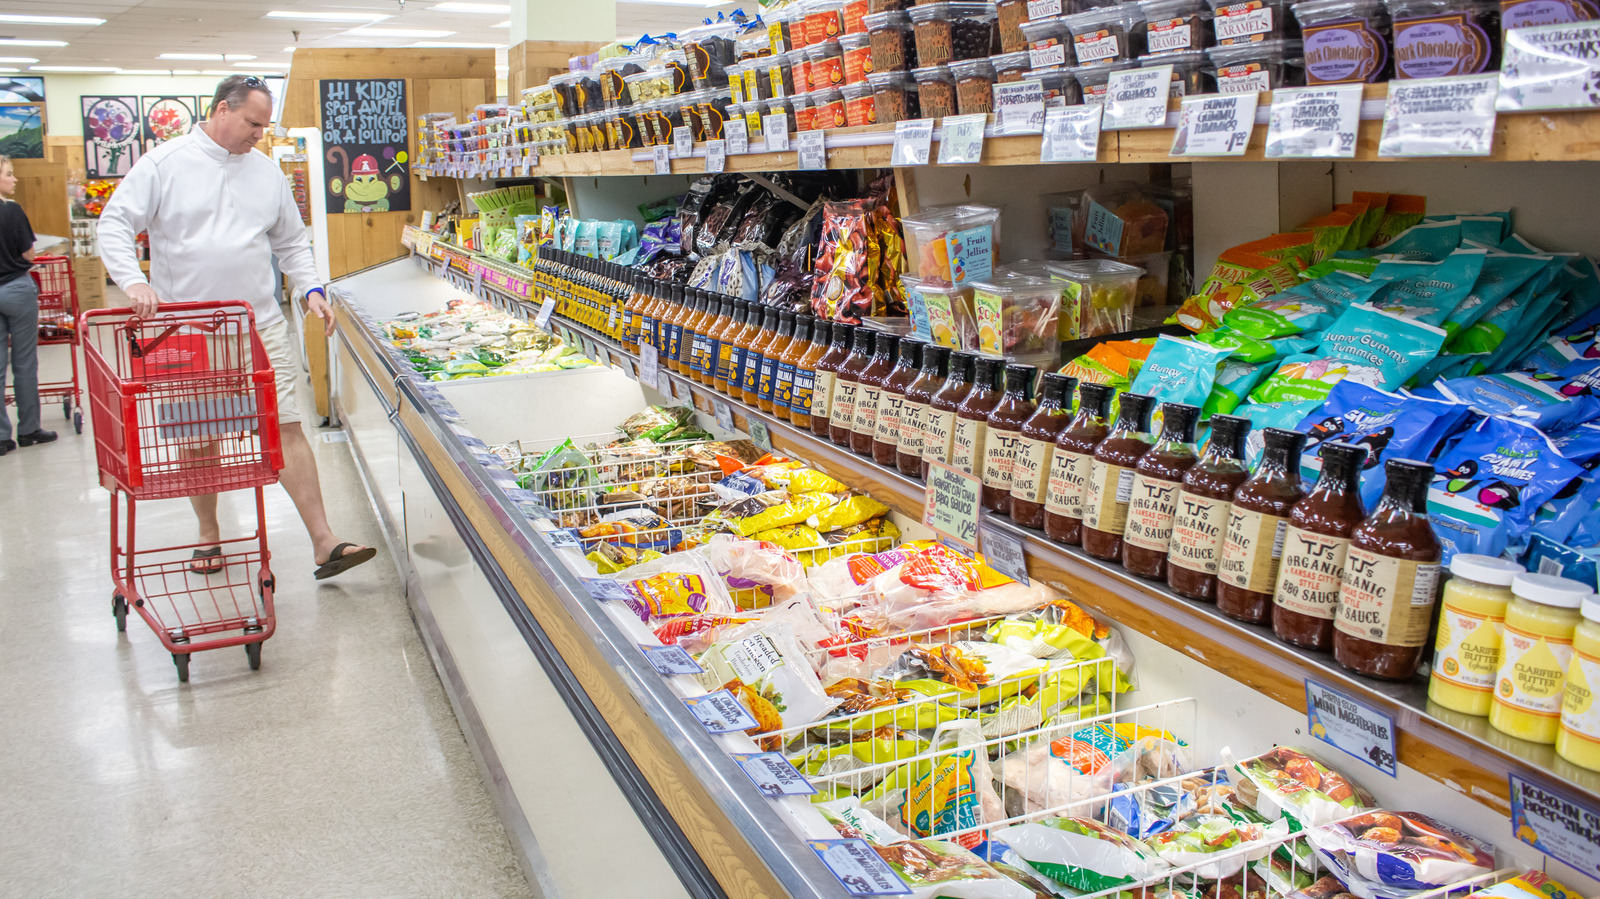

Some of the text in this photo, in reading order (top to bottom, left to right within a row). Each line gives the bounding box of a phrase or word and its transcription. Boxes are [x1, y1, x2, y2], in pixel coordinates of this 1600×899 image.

[327, 81, 403, 101] HI KIDS!
[325, 100, 356, 116] SPOT
[324, 128, 407, 145] OR A LOLLIPOP
[966, 235, 986, 247] Fruit
[966, 247, 989, 259] Jellies
[1332, 342, 1384, 367] Tummies
[1360, 334, 1409, 365] Gummy
[903, 438, 924, 447] SAUCE
[944, 470, 966, 488] ORGANIC
[987, 466, 999, 479] BBQ
[934, 476, 952, 494] KANSAS
[1053, 486, 1066, 496] STYLE
[1064, 481, 1075, 490] CITY
[1143, 483, 1174, 502] TJ's
[936, 490, 949, 508] BBQ
[1054, 494, 1081, 506] SAUCE
[1135, 509, 1172, 523] KANSAS CITY
[1183, 499, 1213, 521] TJ's
[1130, 519, 1172, 540] BBQ SAUC
[1141, 518, 1160, 528] STYLE
[1175, 527, 1209, 542] KANSAS CITY
[1180, 534, 1197, 548] STYLE
[1301, 532, 1335, 546] TRADER JOE'S
[1182, 546, 1215, 560] SAUCE
[1298, 534, 1340, 561] TJ's
[1287, 554, 1345, 580] ORGANIC
[1289, 567, 1335, 585] KANSAS CITY
[1298, 577, 1320, 591] STYLE
[1282, 579, 1341, 605] BBQ SAUCE
[1358, 590, 1375, 604] CITY
[1344, 596, 1361, 609] STYLE
[1345, 607, 1381, 625] SAUCE
[753, 634, 781, 665] Breaded
[1460, 642, 1500, 657] CLARIFIE
[1463, 652, 1499, 665] BUTTER
[1468, 661, 1493, 673] (ghee)
[1514, 662, 1564, 680] CLARIFIED
[1517, 673, 1557, 689] BUTTER
[1521, 681, 1549, 696] (ghee)
[719, 696, 744, 718] CHICKEN
[1321, 689, 1358, 714] PARTY SIZE
[1313, 694, 1389, 740] MINI MEATBALLS
[760, 758, 794, 786] MEATBALLS
[1521, 782, 1580, 821] KOREAN
